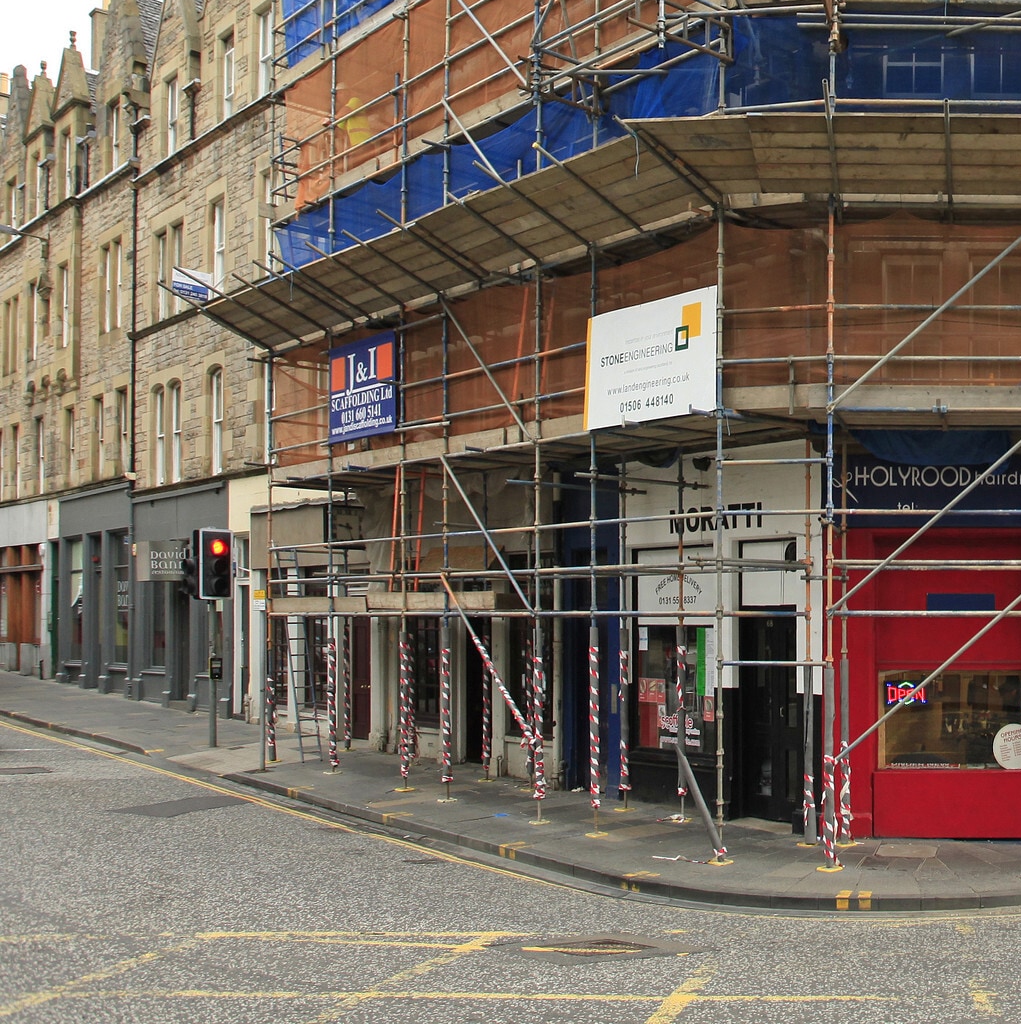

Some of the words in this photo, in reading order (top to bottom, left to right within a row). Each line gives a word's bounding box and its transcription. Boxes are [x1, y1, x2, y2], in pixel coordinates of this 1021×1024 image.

[600, 342, 674, 368] STONEENGINEERING
[346, 346, 376, 395] J&I
[607, 372, 690, 396] www.landengineering.co.uk
[331, 388, 380, 412] SCAFFOLDING
[380, 385, 393, 401] Ltd
[619, 399, 641, 413] 01506
[645, 393, 674, 408] 448140
[341, 409, 355, 425] 0131
[355, 406, 367, 422] 660
[367, 403, 381, 419] 5141
[854, 465, 971, 487] HOLYROOD
[150, 547, 187, 559] David
[655, 578, 667, 595] FREE
[684, 574, 702, 595] ELIVERY
[658, 596, 671, 605] 0131
[887, 685, 926, 703] OPEN
